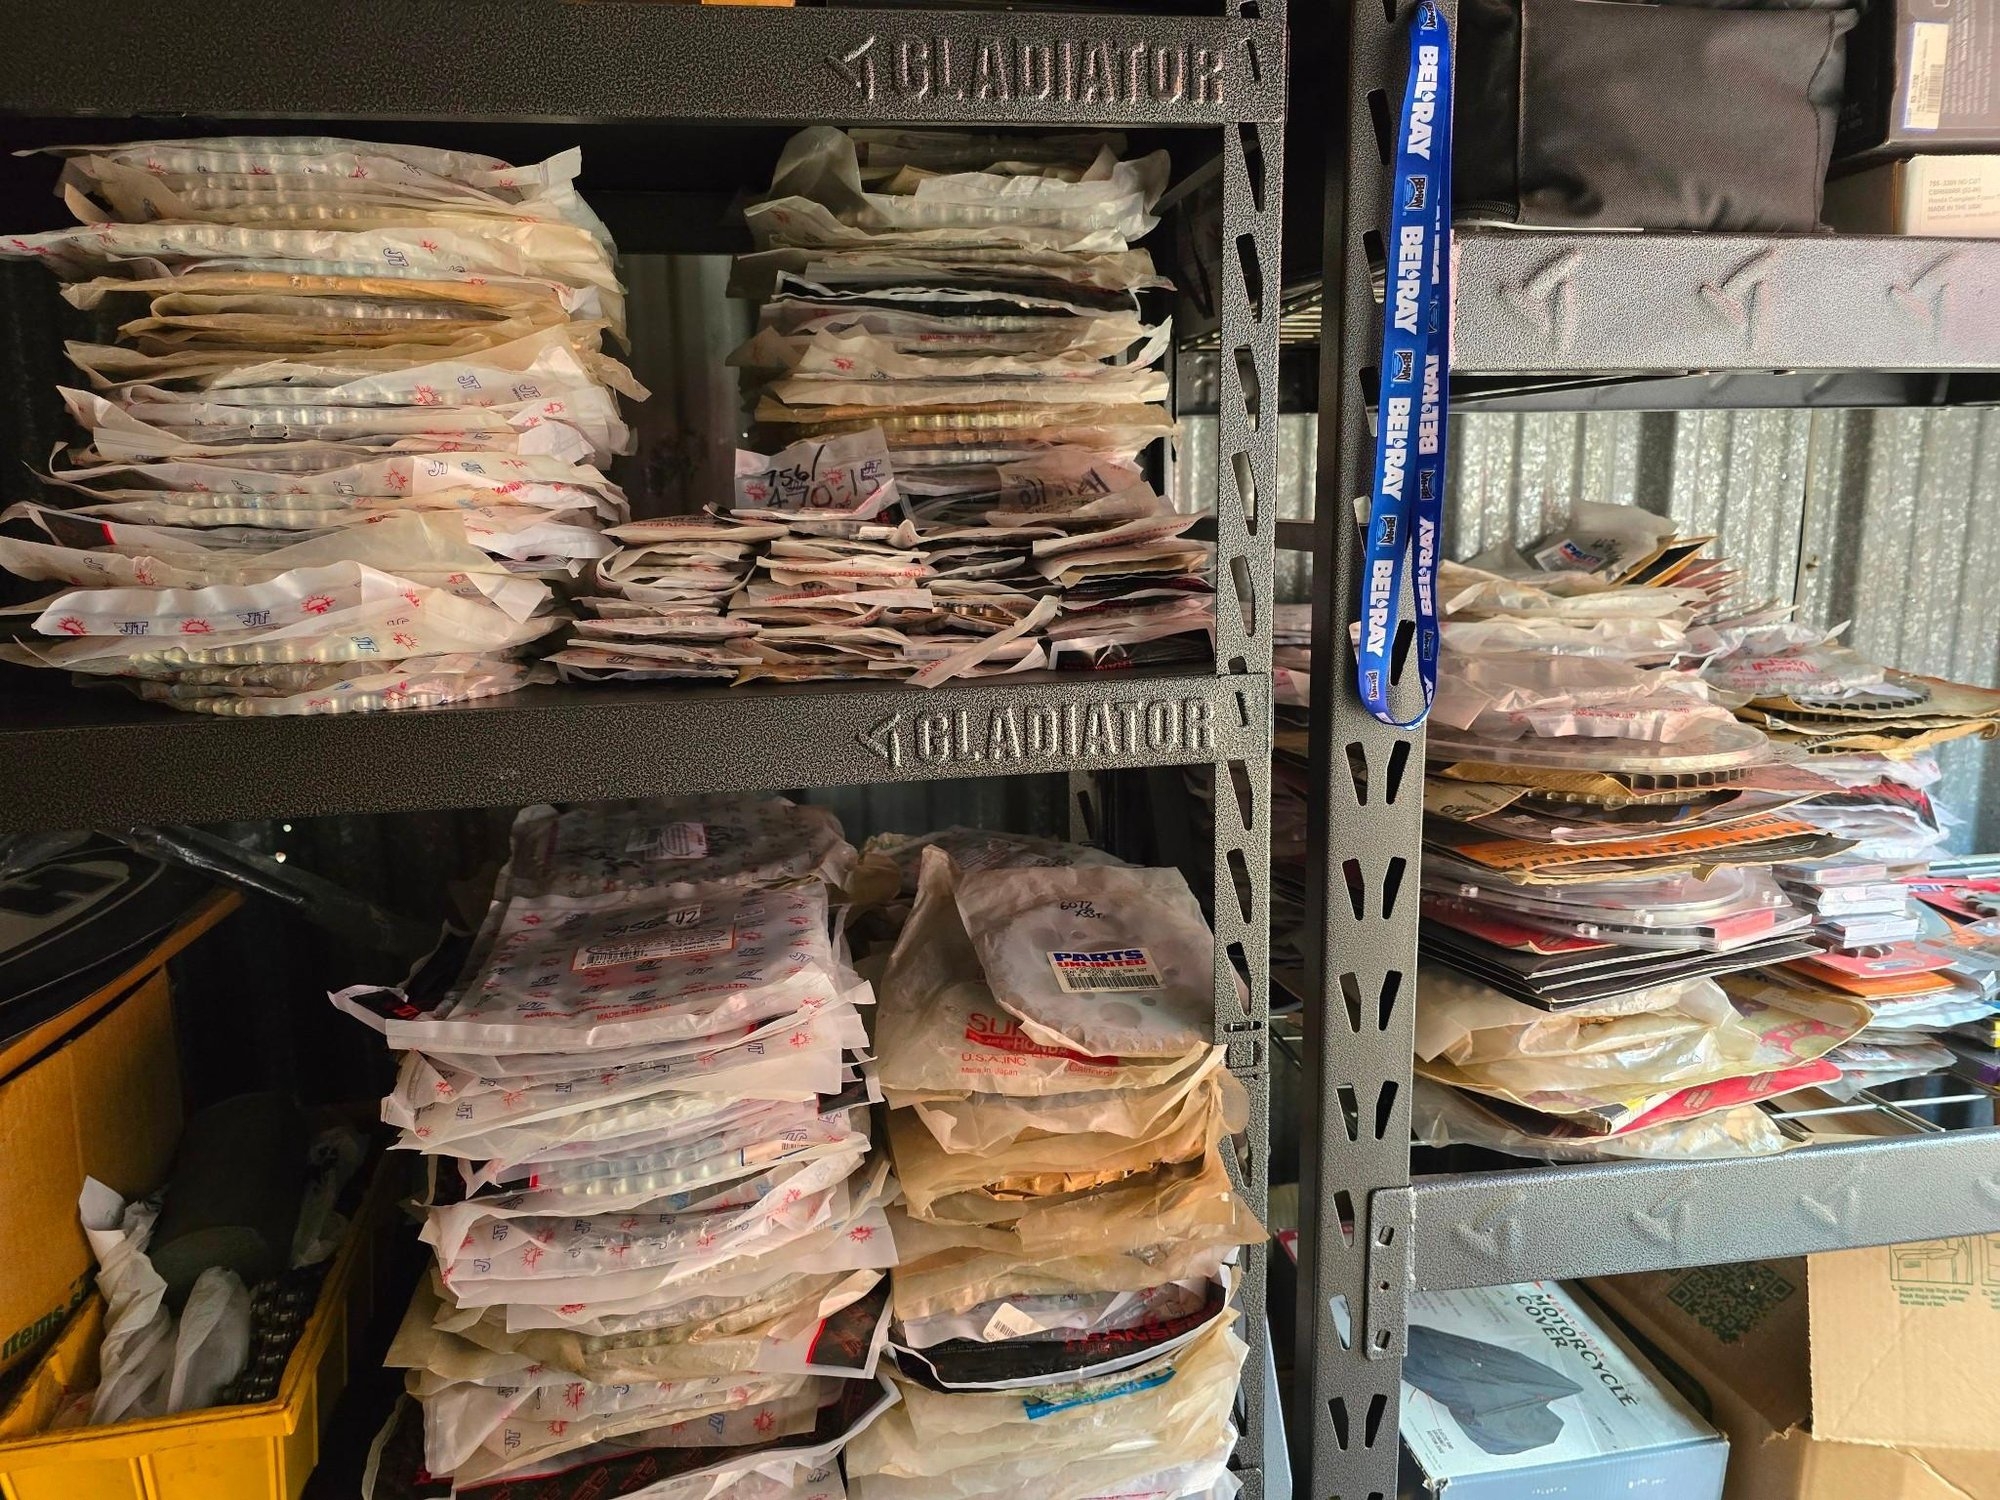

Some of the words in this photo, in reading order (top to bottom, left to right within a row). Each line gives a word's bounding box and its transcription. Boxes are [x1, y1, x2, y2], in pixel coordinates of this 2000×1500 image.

[894, 36, 1225, 104] GLADIATOR
[914, 697, 1218, 764] GLADIATOR
[1053, 949, 1145, 962] PARTS
[1056, 959, 1148, 968] UNLIMITED
[1515, 1294, 1569, 1349] COVER
[1529, 1293, 1638, 1408] MOTORCYCLE
